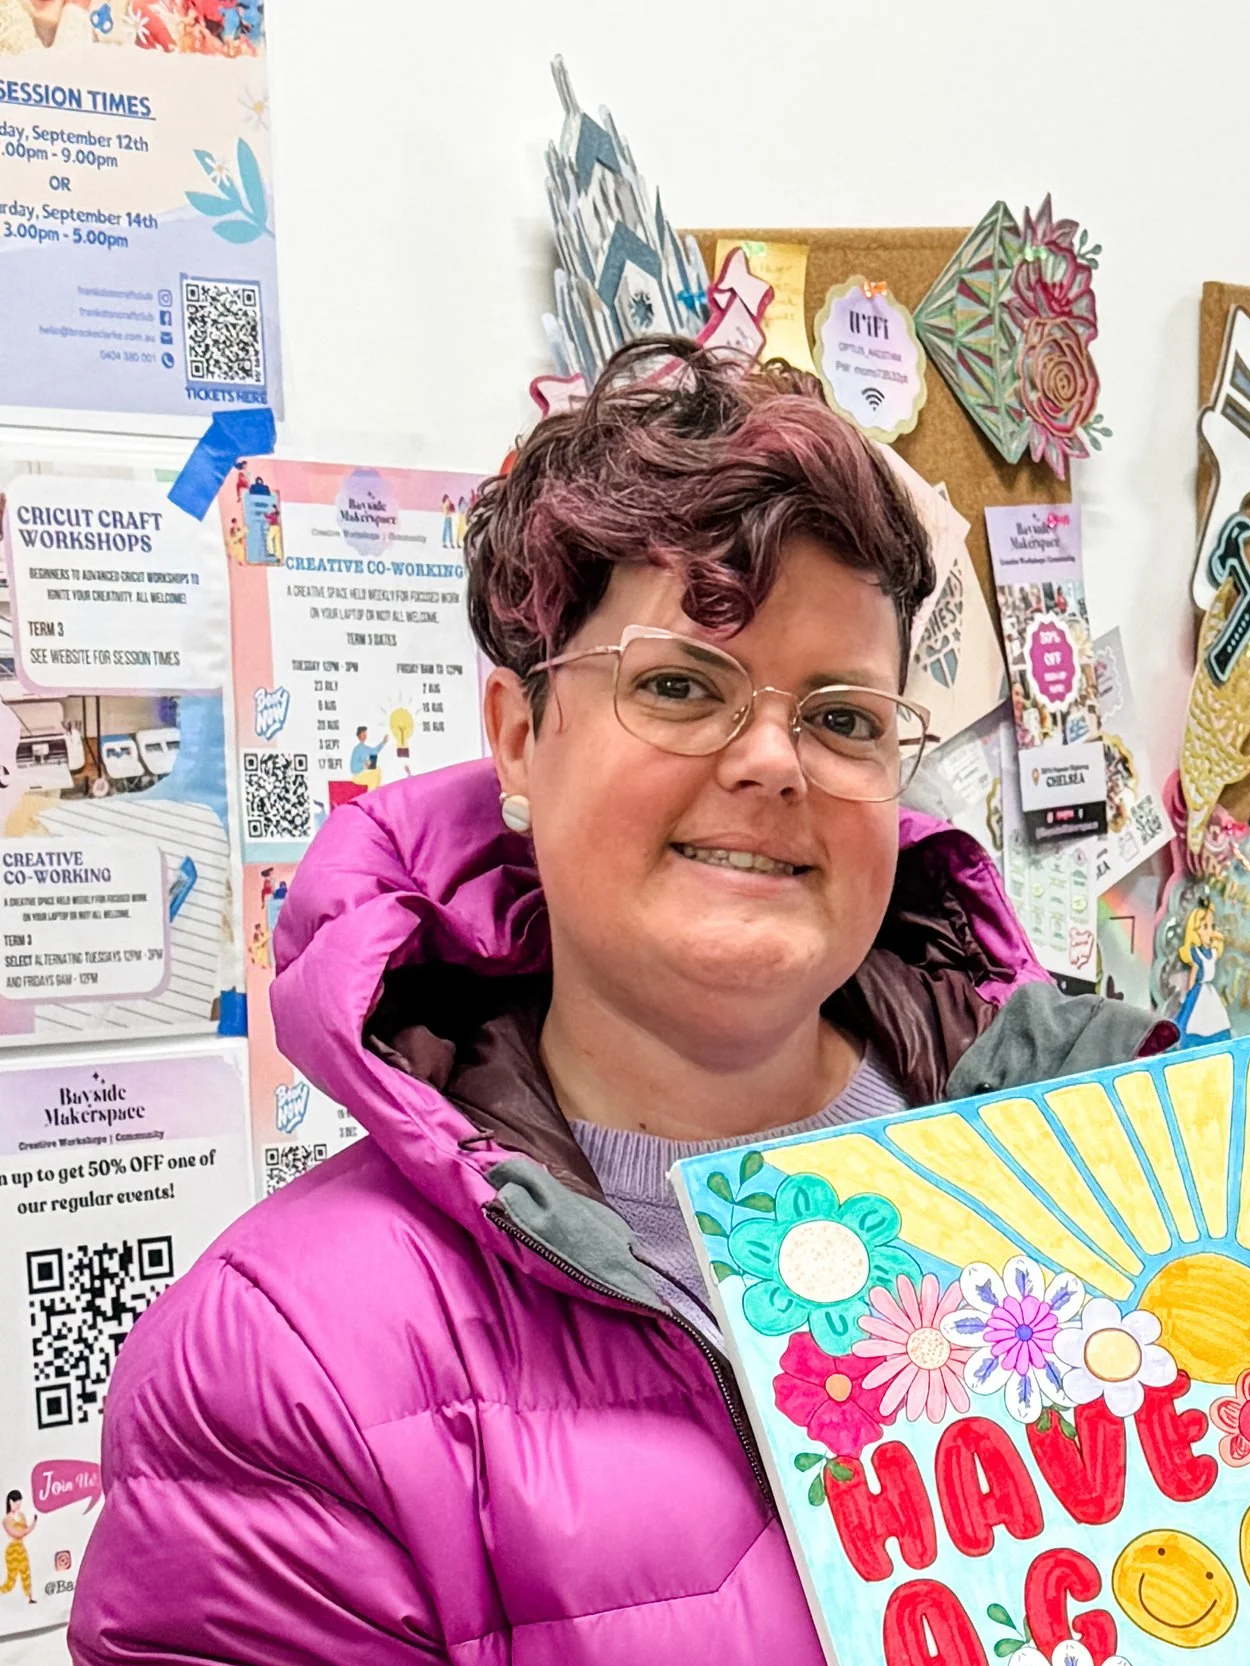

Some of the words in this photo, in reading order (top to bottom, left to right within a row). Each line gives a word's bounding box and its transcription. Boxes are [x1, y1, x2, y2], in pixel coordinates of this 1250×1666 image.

[87, 91, 152, 116] TIMES
[32, 125, 112, 148] September
[116, 134, 149, 152] 12th
[61, 148, 118, 169] 9.00pm
[49, 176, 72, 191] OR
[42, 204, 122, 225] September
[125, 212, 158, 229] 14th
[3, 222, 60, 243] 3.00pm
[72, 228, 129, 249] 5.00pm
[186, 387, 234, 402] TICKETS
[235, 389, 268, 404] HERE
[17, 505, 94, 530] CRICUT
[97, 509, 163, 532] CRAFT
[18, 528, 153, 553] WORKSHOPS
[29, 567, 70, 581] BEGINNERS
[71, 569, 81, 581] TO
[286, 556, 364, 575] CREATIVE
[367, 559, 464, 580] CO-WORKING
[72, 589, 91, 602] YOUR
[136, 591, 149, 603] ALL
[28, 620, 56, 636] TERM
[57, 621, 65, 637] 3
[30, 648, 48, 664] SEE
[50, 648, 91, 665] WEBSITE
[94, 650, 111, 665] FOR
[113, 651, 151, 666] SESSION
[153, 651, 181, 667] TIMES
[1046, 772, 1085, 788] CHELSEA
[3, 851, 84, 867] CREATIVE
[3, 868, 112, 885] CO-WORKING
[4, 934, 25, 947] TERM
[5, 954, 34, 968] SELECT
[34, 952, 84, 966] ALTERNATING
[84, 950, 122, 964] TUESDAYS
[6, 975, 22, 988] AND
[22, 974, 54, 988] FRIDAYS
[60, 1084, 127, 1108] Bayside
[45, 1105, 146, 1127] Makerspace
[18, 1140, 57, 1151] Creative
[58, 1136, 107, 1148] Workshops
[115, 1130, 165, 1142] Community
[11, 1171, 33, 1188] up
[37, 1167, 55, 1183] to
[58, 1164, 85, 1184] get
[88, 1158, 127, 1178] 50%
[129, 1154, 164, 1173] OFF
[167, 1154, 196, 1170] one
[199, 1148, 217, 1166] of
[17, 1200, 47, 1215] our
[51, 1190, 114, 1214] regular
[117, 1183, 176, 1205] events!
[39, 1471, 74, 1501] Join
[824, 1369, 1219, 1583] HAVE
